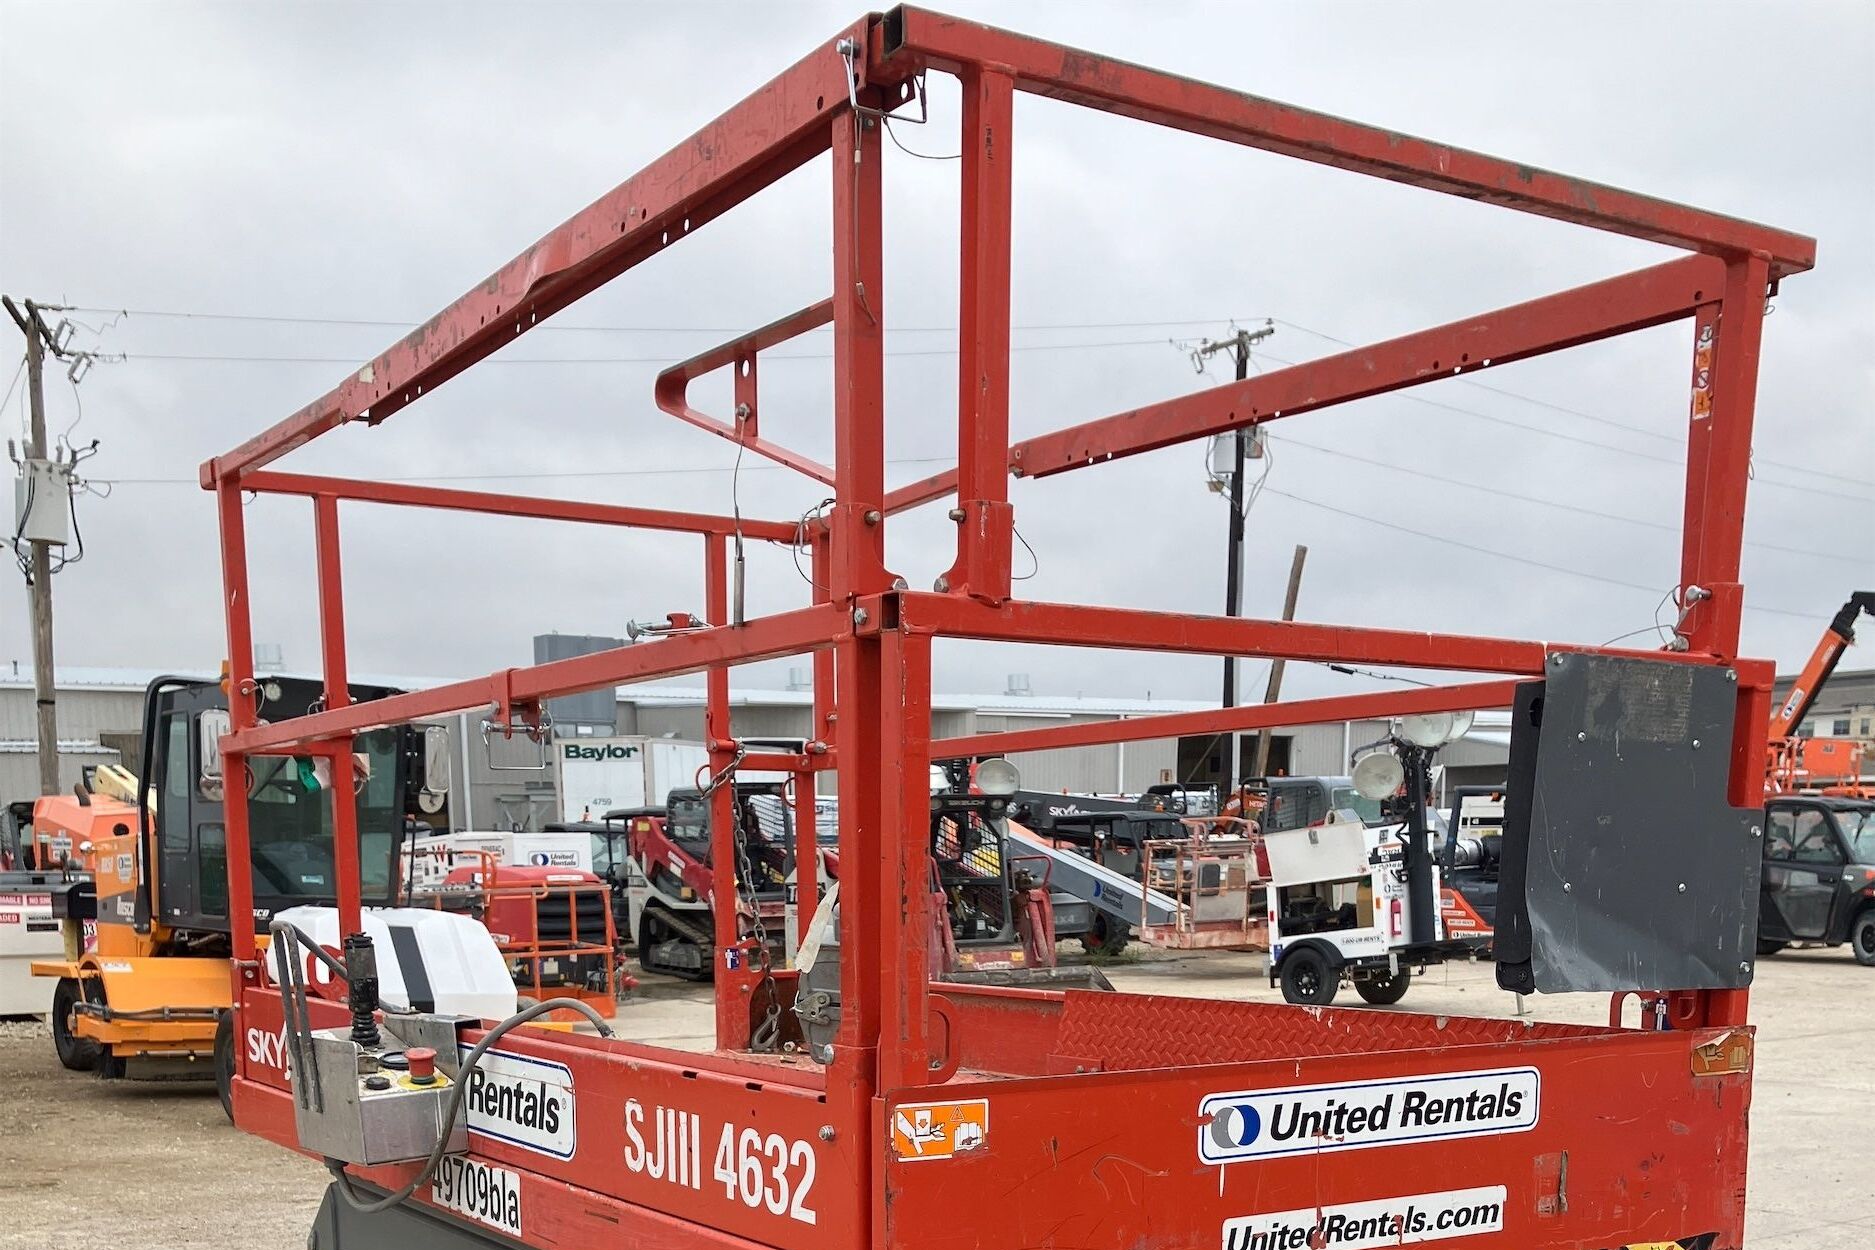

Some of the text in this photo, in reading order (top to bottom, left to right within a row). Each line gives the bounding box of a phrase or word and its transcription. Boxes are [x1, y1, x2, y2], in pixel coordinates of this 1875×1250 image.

[565, 744, 638, 761] Baylor
[592, 798, 612, 806] 4759
[469, 1064, 559, 1134] Rentals
[1271, 1083, 1523, 1142] United Rentals
[624, 1097, 816, 1225] SJIII 4632
